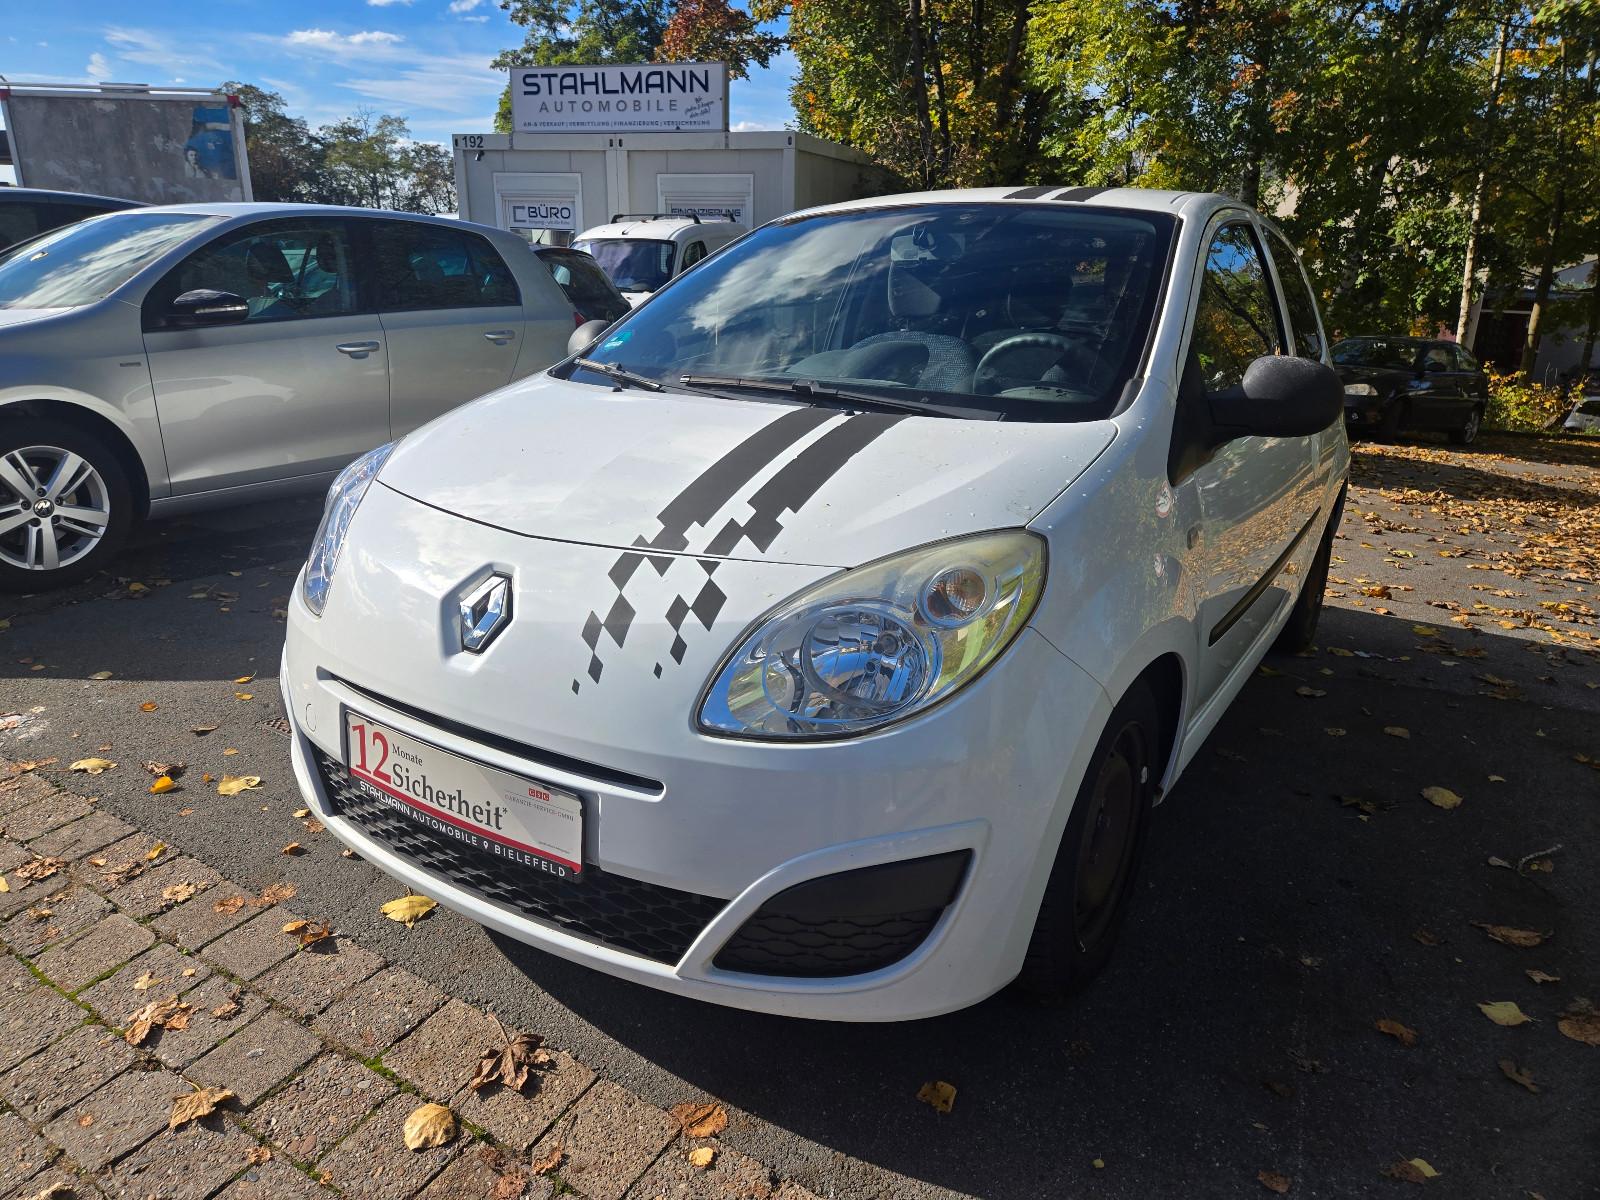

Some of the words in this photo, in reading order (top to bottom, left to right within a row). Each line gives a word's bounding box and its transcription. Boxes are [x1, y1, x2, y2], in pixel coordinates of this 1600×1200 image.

[522, 69, 709, 96] STAHLMANN
[539, 99, 678, 113] AUTOMOBILE
[462, 136, 484, 149] 192
[527, 203, 571, 219] BÜRO
[351, 724, 392, 785] 12
[392, 743, 423, 767] Monate
[360, 781, 410, 815] STAHLMANN
[412, 810, 478, 846] AUTOMOBILE
[494, 844, 566, 877] BIELEFELD
